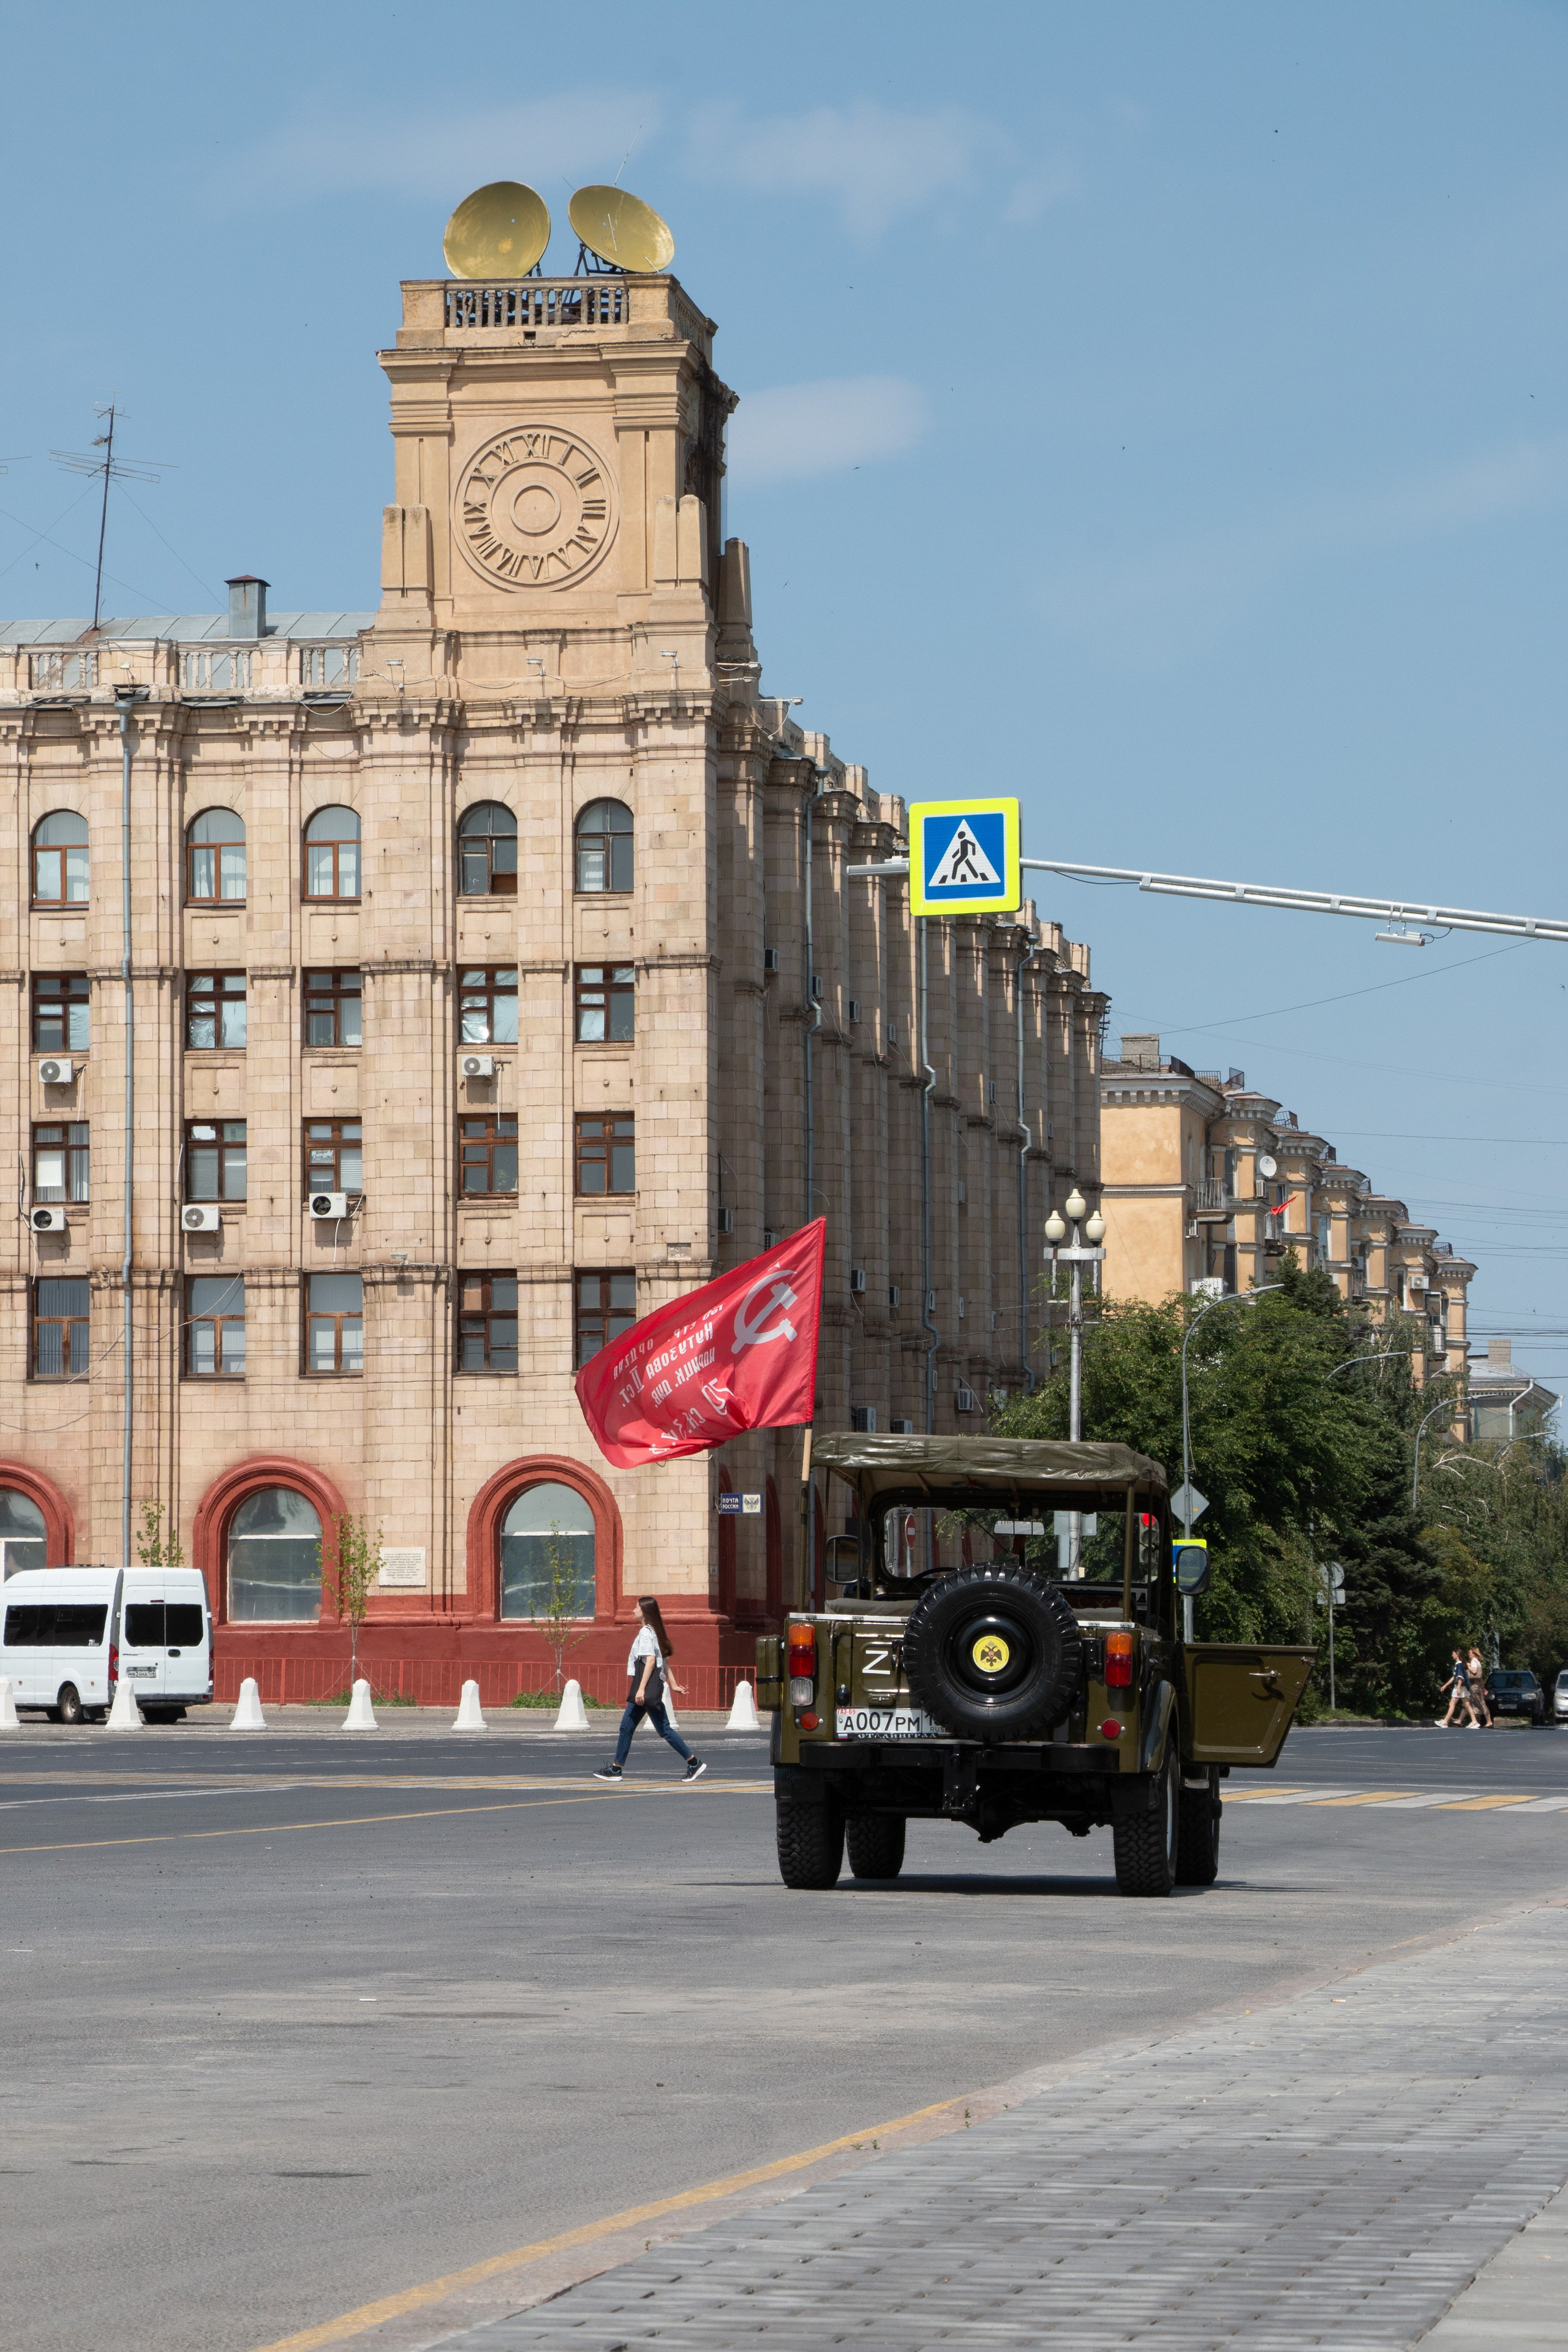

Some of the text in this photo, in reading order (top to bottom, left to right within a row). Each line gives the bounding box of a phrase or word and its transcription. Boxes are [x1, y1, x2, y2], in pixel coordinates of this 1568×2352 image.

[522, 432, 551, 459] XII
[575, 465, 600, 489] II
[582, 497, 606, 520] III
[496, 546, 525, 578] VII
[528, 554, 550, 579] VI
[862, 1649, 891, 1675] Z
[843, 1711, 920, 1732] А007РМ
